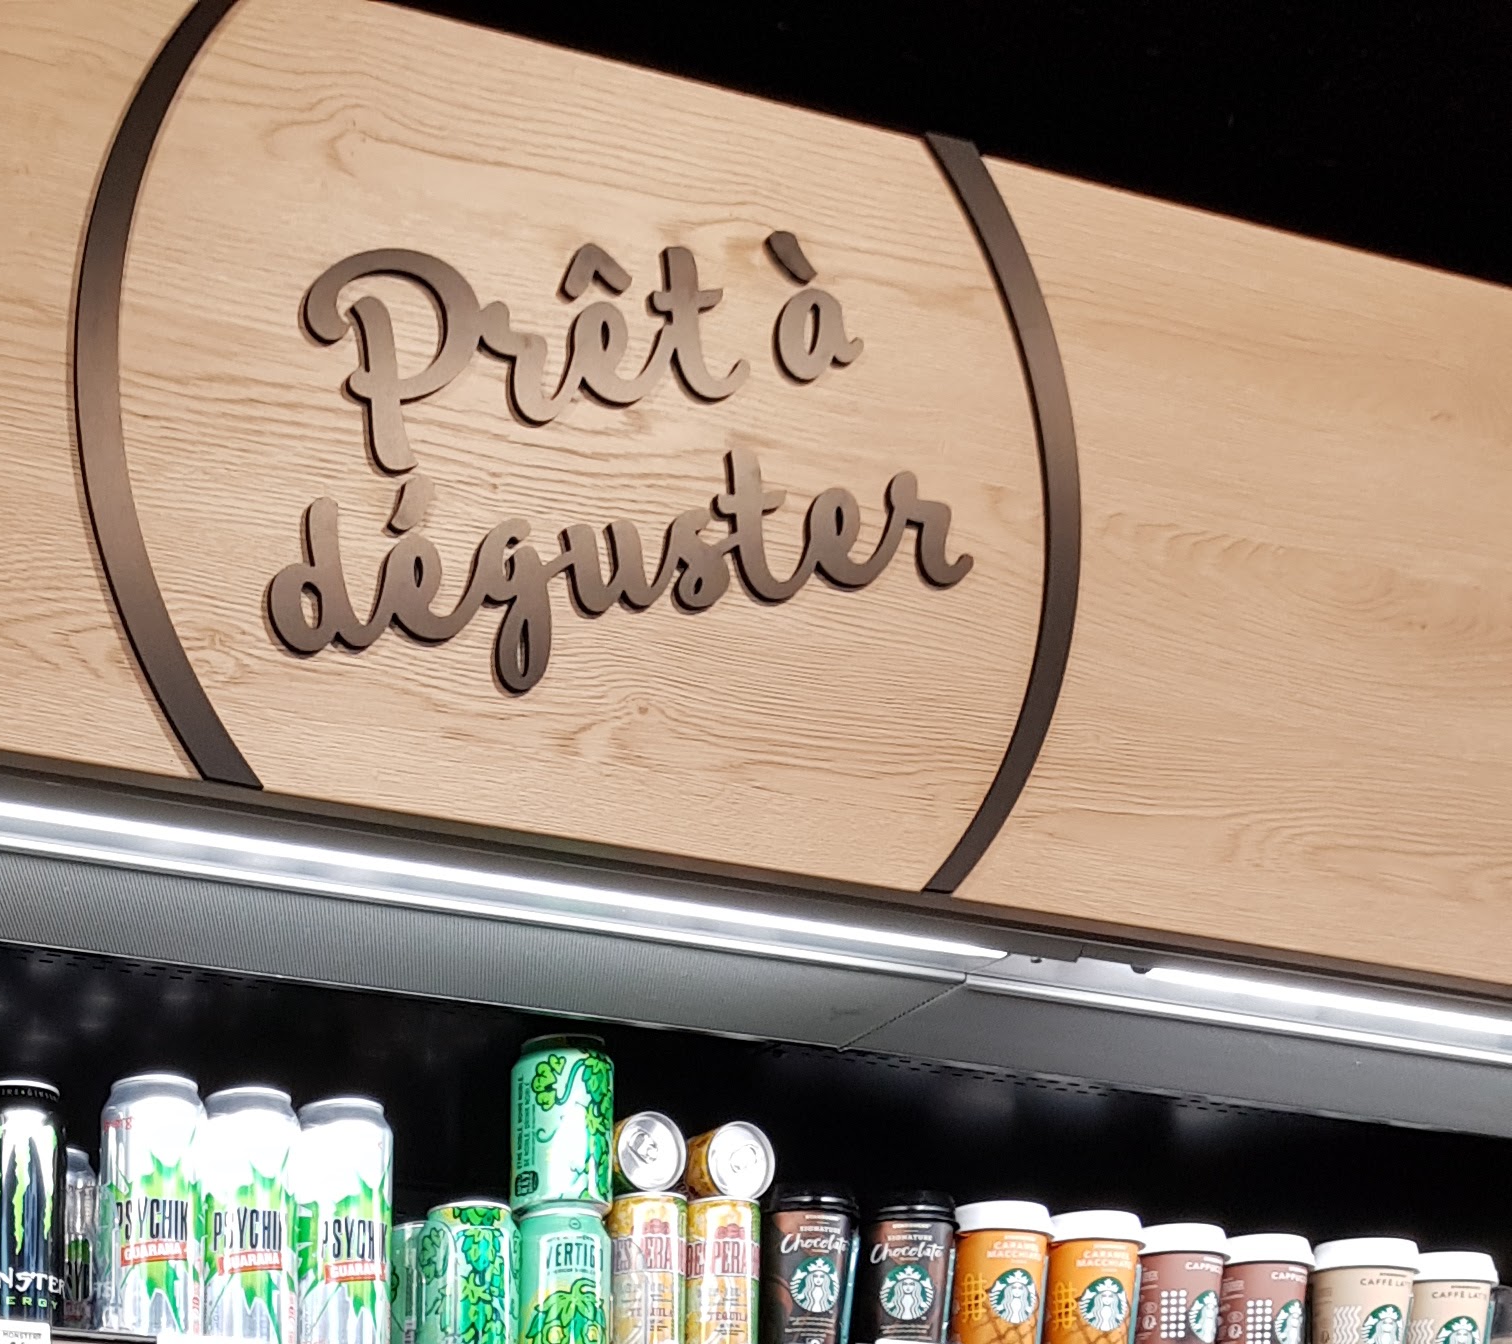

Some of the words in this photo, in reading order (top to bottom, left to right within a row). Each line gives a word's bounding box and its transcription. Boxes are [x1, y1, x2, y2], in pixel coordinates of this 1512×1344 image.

[298, 243, 750, 474] Prêt
[763, 230, 864, 383] à
[263, 449, 973, 695] déguster
[780, 1233, 848, 1254] Chocolate
[871, 1240, 944, 1263] Chocolate
